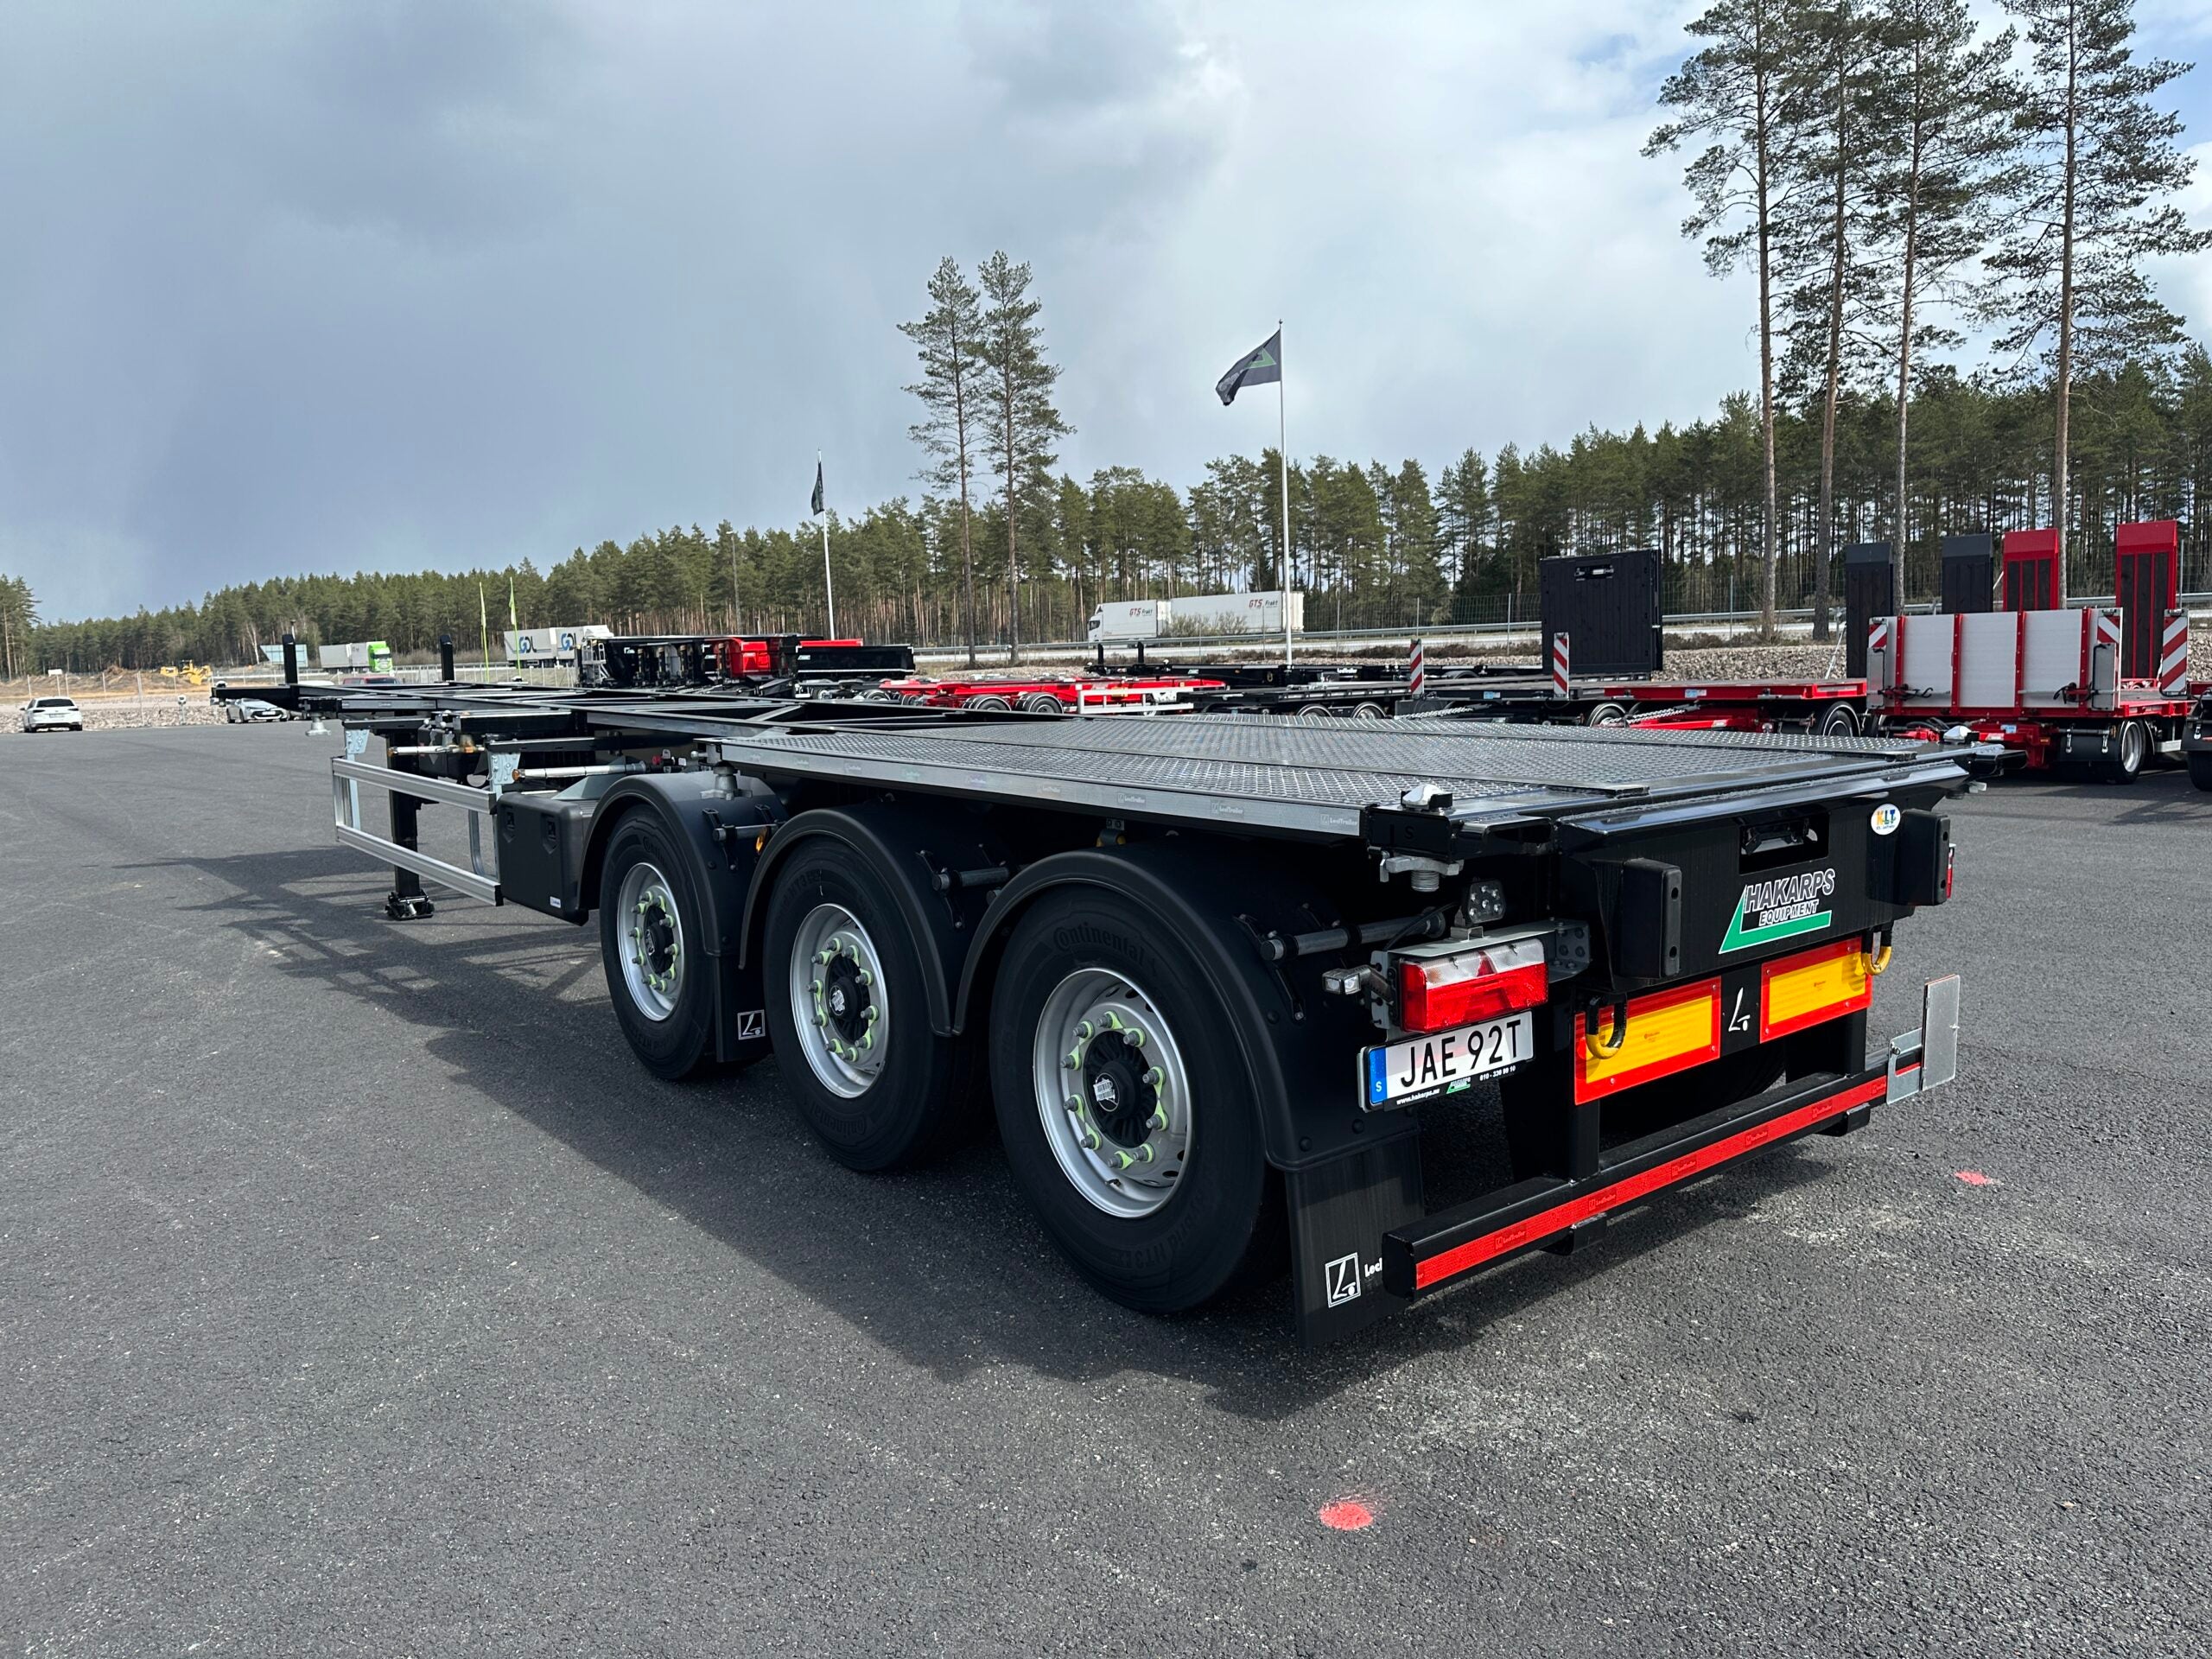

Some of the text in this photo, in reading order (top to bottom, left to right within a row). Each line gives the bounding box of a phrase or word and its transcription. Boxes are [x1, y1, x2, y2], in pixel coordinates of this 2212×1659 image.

[1129, 607, 1141, 616] GTS
[1249, 599, 1263, 608] GTS
[1745, 868, 1835, 913] HAKARPS
[1758, 899, 1819, 927] EQUIPMENT
[1053, 925, 1145, 967] Continental
[1401, 1020, 1521, 1088] JAE 92T
[1376, 1081, 1382, 1093] S
